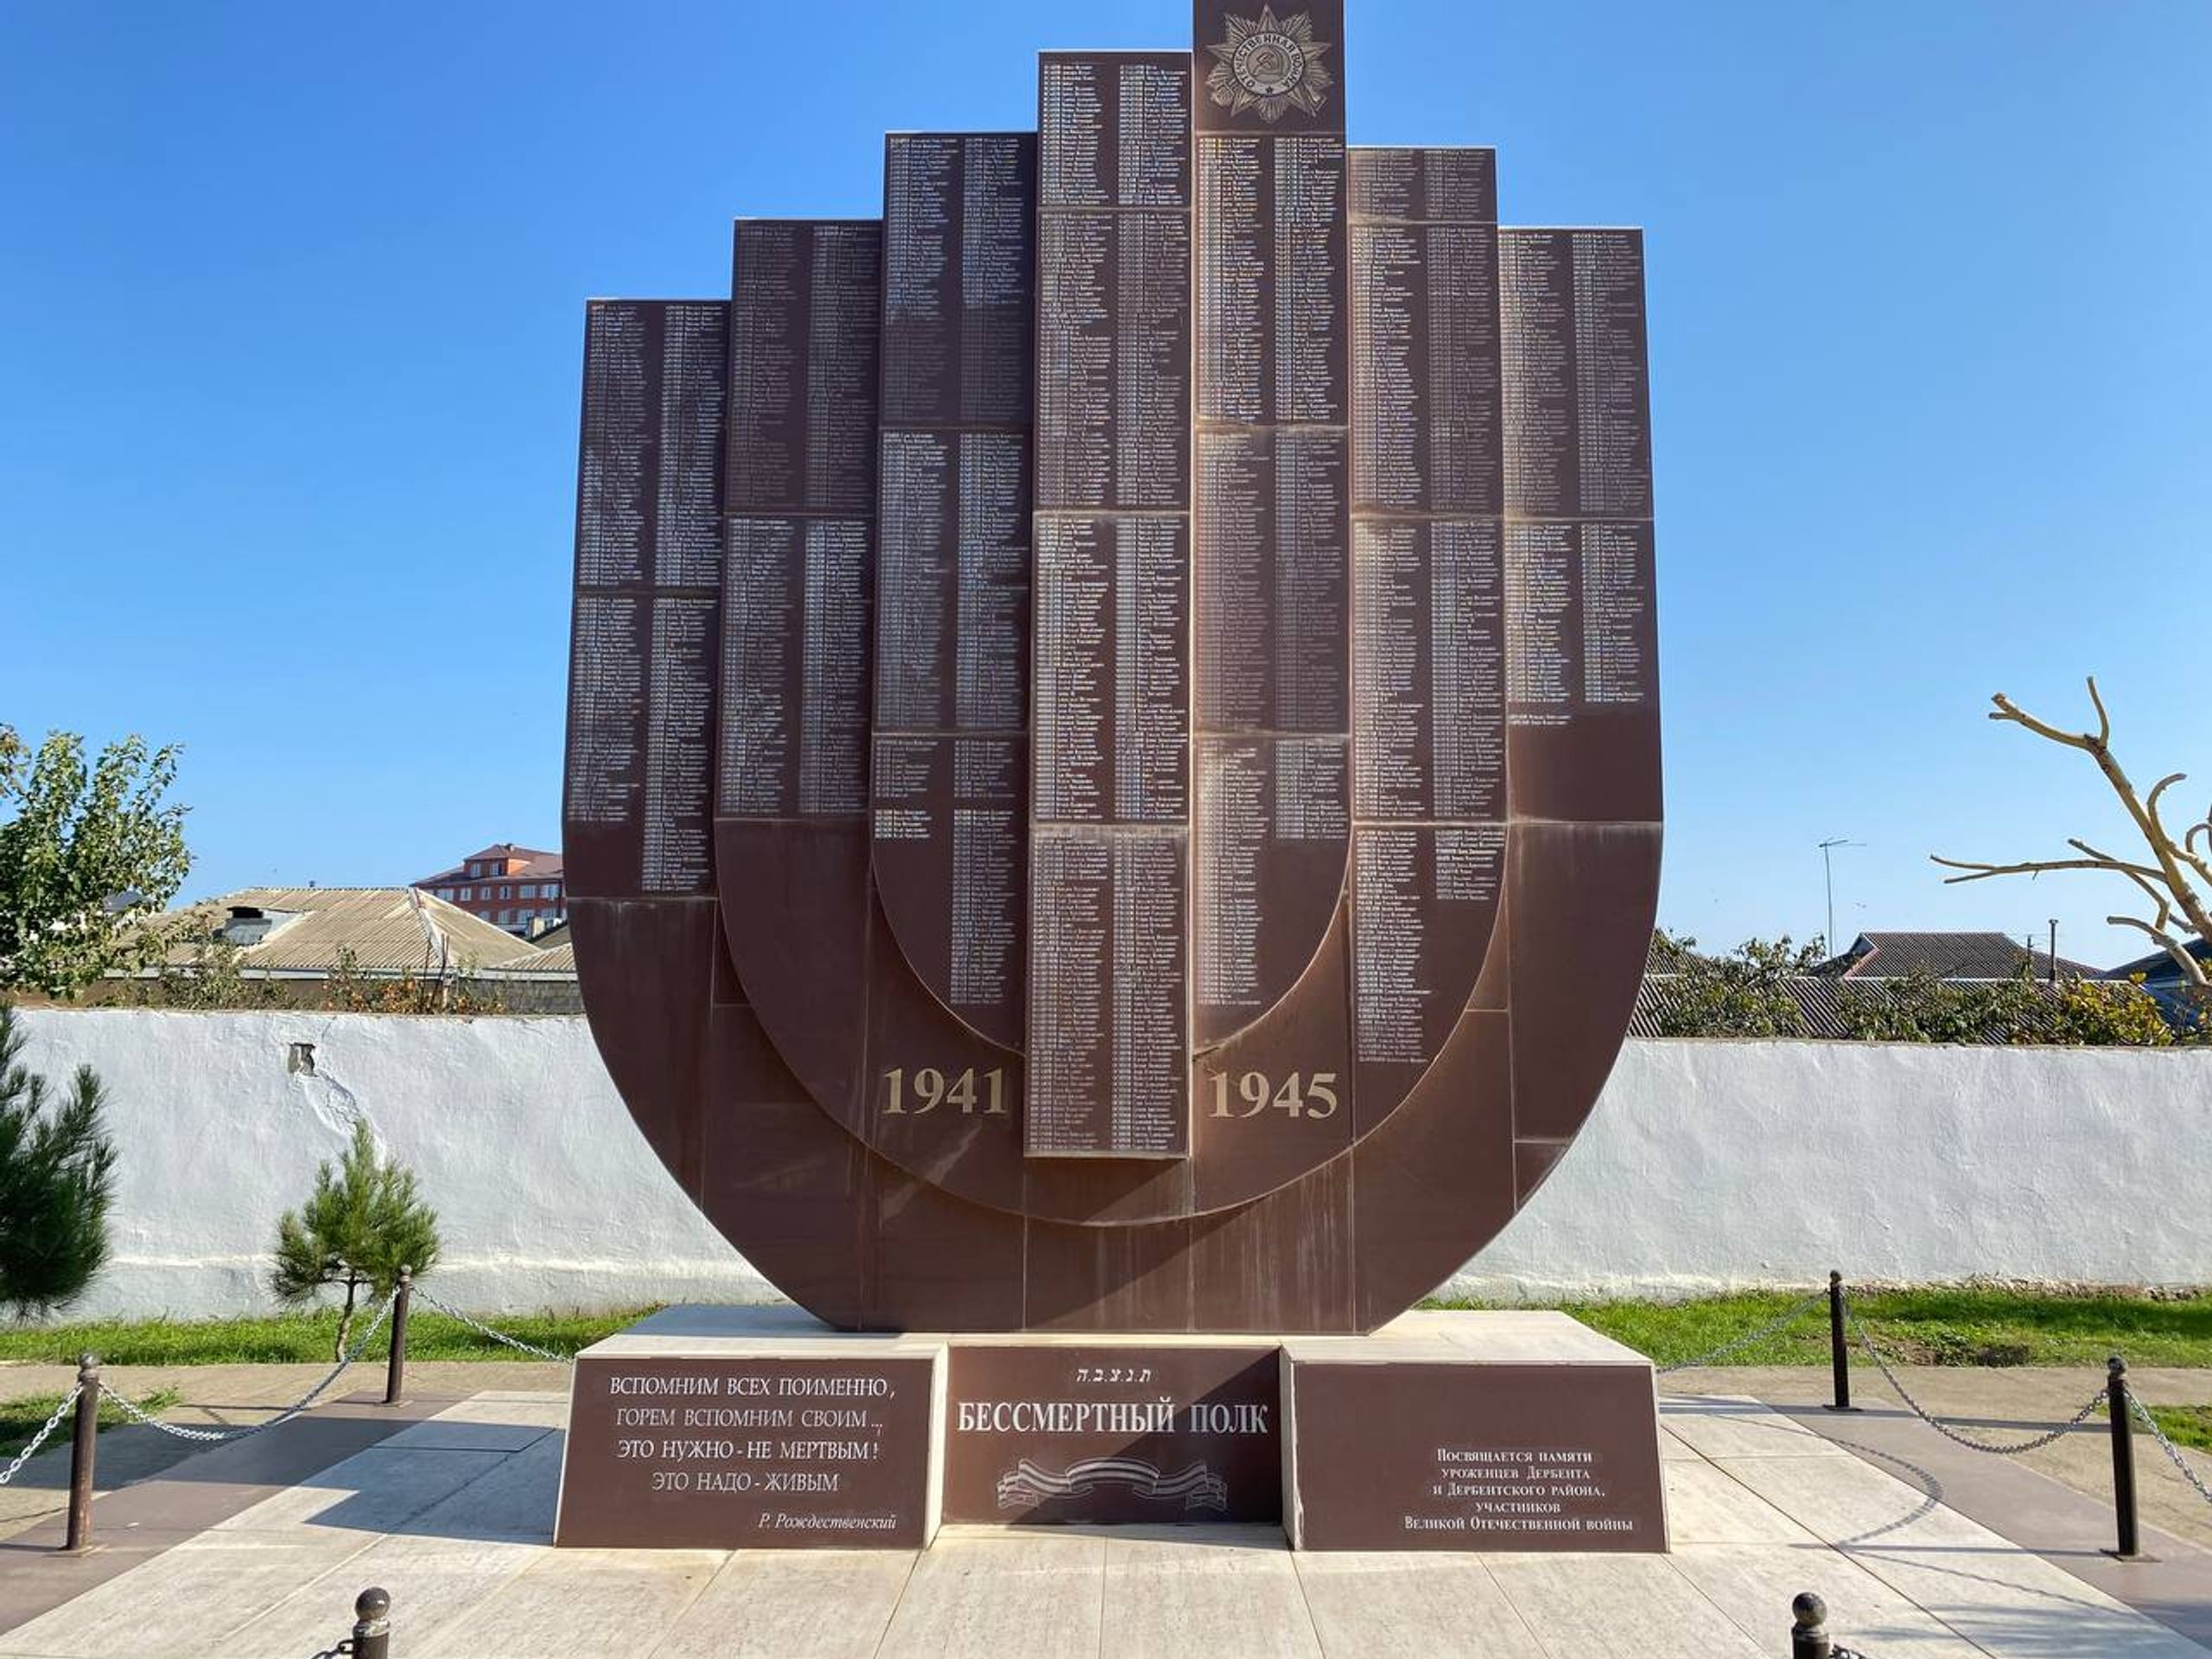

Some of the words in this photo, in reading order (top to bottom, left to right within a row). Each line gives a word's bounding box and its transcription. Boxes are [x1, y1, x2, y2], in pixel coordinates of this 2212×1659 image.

[882, 1067, 1008, 1115] 1941
[1209, 1071, 1338, 1120] 1945
[609, 1376, 719, 1395] ВСПОМНИМ
[728, 1377, 771, 1396] ВСЕХ
[779, 1377, 895, 1399] ПОИМЕННО,
[616, 1408, 677, 1426] ГОРЕМ
[684, 1409, 794, 1427] ВСПОМНИМ
[957, 1396, 1176, 1433] БЕССМЕРТНЫЙ
[1188, 1403, 1268, 1434] ПОЛК
[618, 1440, 655, 1459] ЭТО
[662, 1440, 734, 1462] НУЖНО
[747, 1440, 772, 1459] НЕ
[652, 1471, 690, 1491] ЭТО
[696, 1472, 752, 1493] НАДО
[764, 1472, 840, 1491] ЖИВЫМ
[774, 1512, 898, 1529] Рождественский
